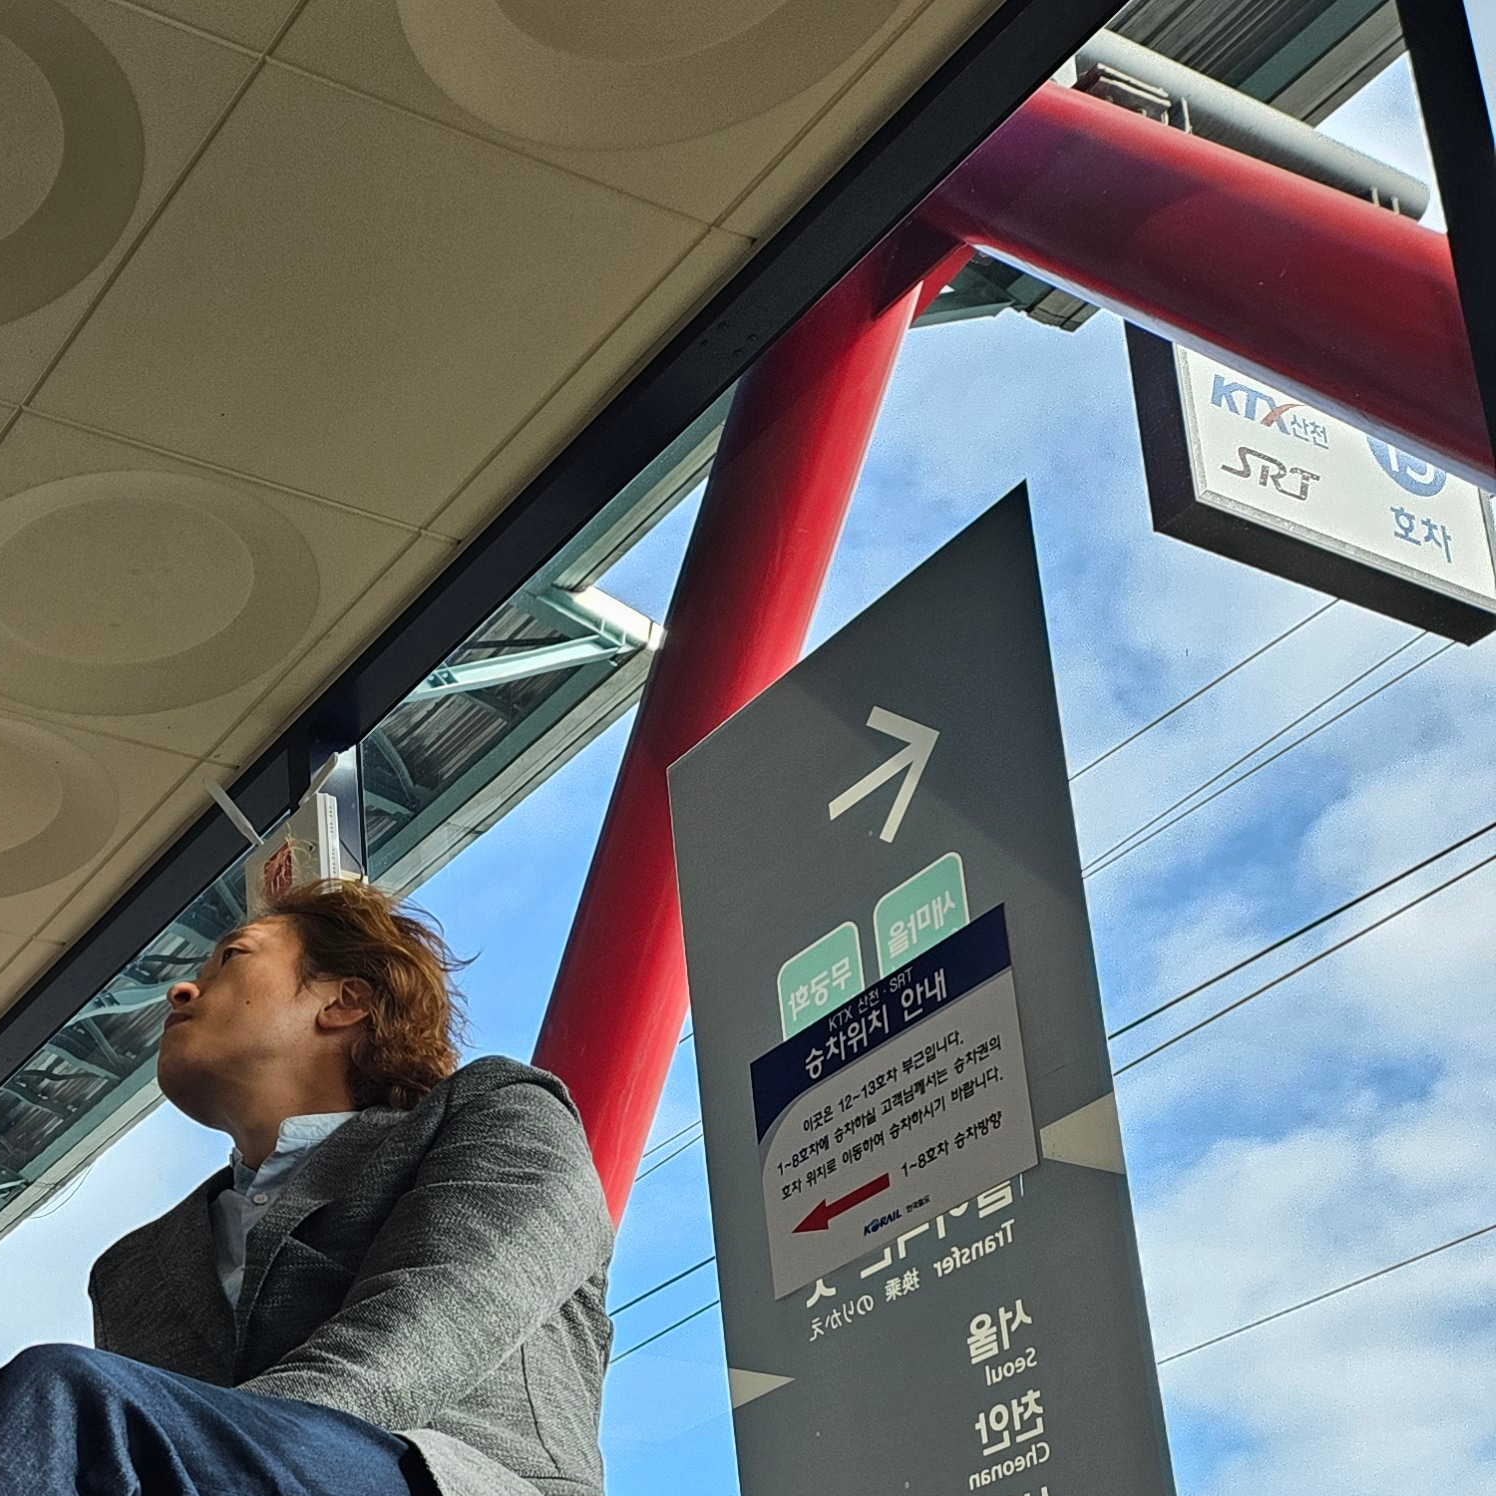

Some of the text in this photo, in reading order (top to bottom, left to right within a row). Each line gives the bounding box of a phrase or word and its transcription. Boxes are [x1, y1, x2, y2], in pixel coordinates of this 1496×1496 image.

[1220, 446, 1320, 501] SRT
[1390, 506, 1452, 563] 호차
[804, 967, 948, 1080] 승차위치 안내
[828, 1008, 854, 1032] KTX
[889, 966, 914, 993] SRT
[803, 1105, 834, 1133] 이곳은
[901, 1110, 1003, 1177] 1~8호차 승차방향
[864, 1208, 903, 1237] KORAIL
